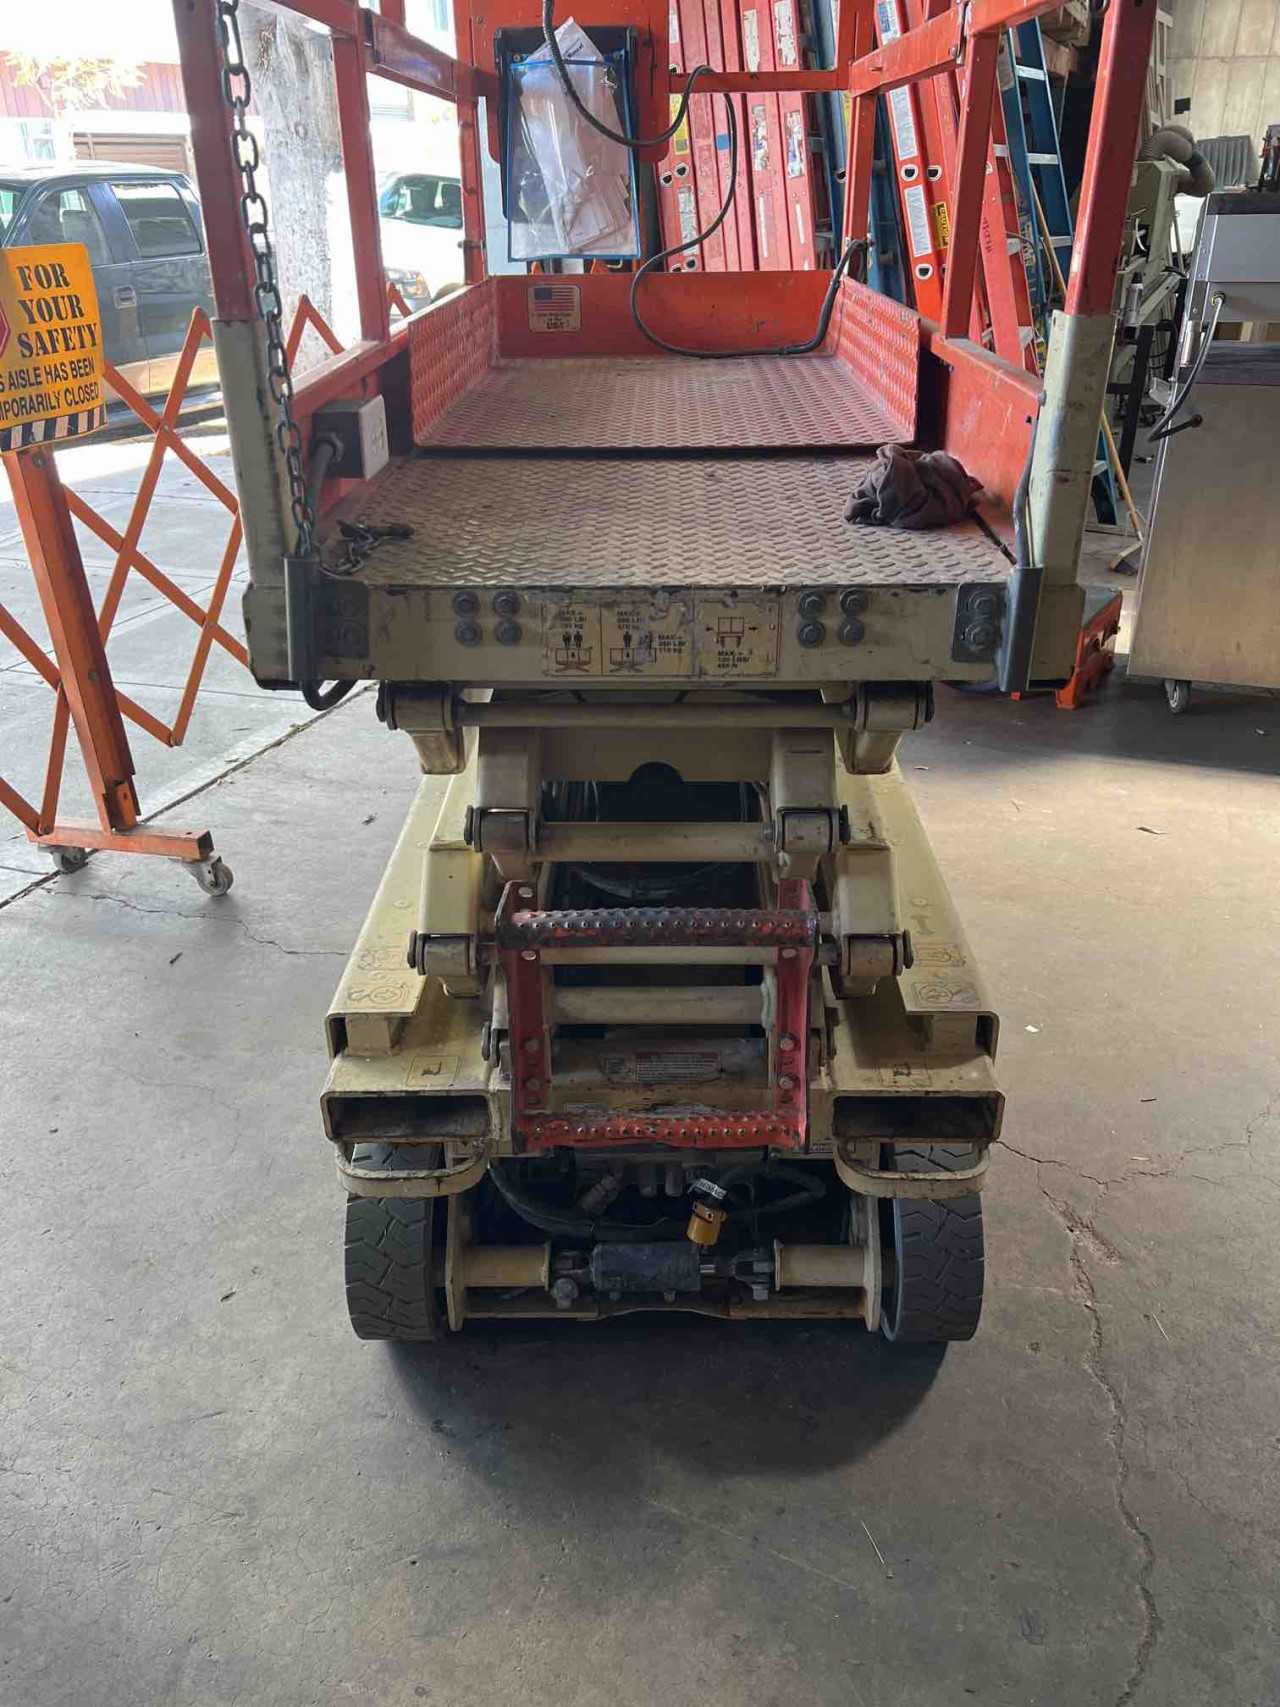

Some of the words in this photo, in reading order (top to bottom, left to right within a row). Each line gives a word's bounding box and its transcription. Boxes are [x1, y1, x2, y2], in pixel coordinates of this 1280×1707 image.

[16, 263, 70, 291] FOR
[17, 294, 84, 324] YOUR
[17, 322, 97, 358] SAFETY
[9, 366, 43, 391] AISLE
[44, 362, 69, 385] HAS
[69, 356, 96, 379] BEEN
[64, 382, 99, 407] CLOSED
